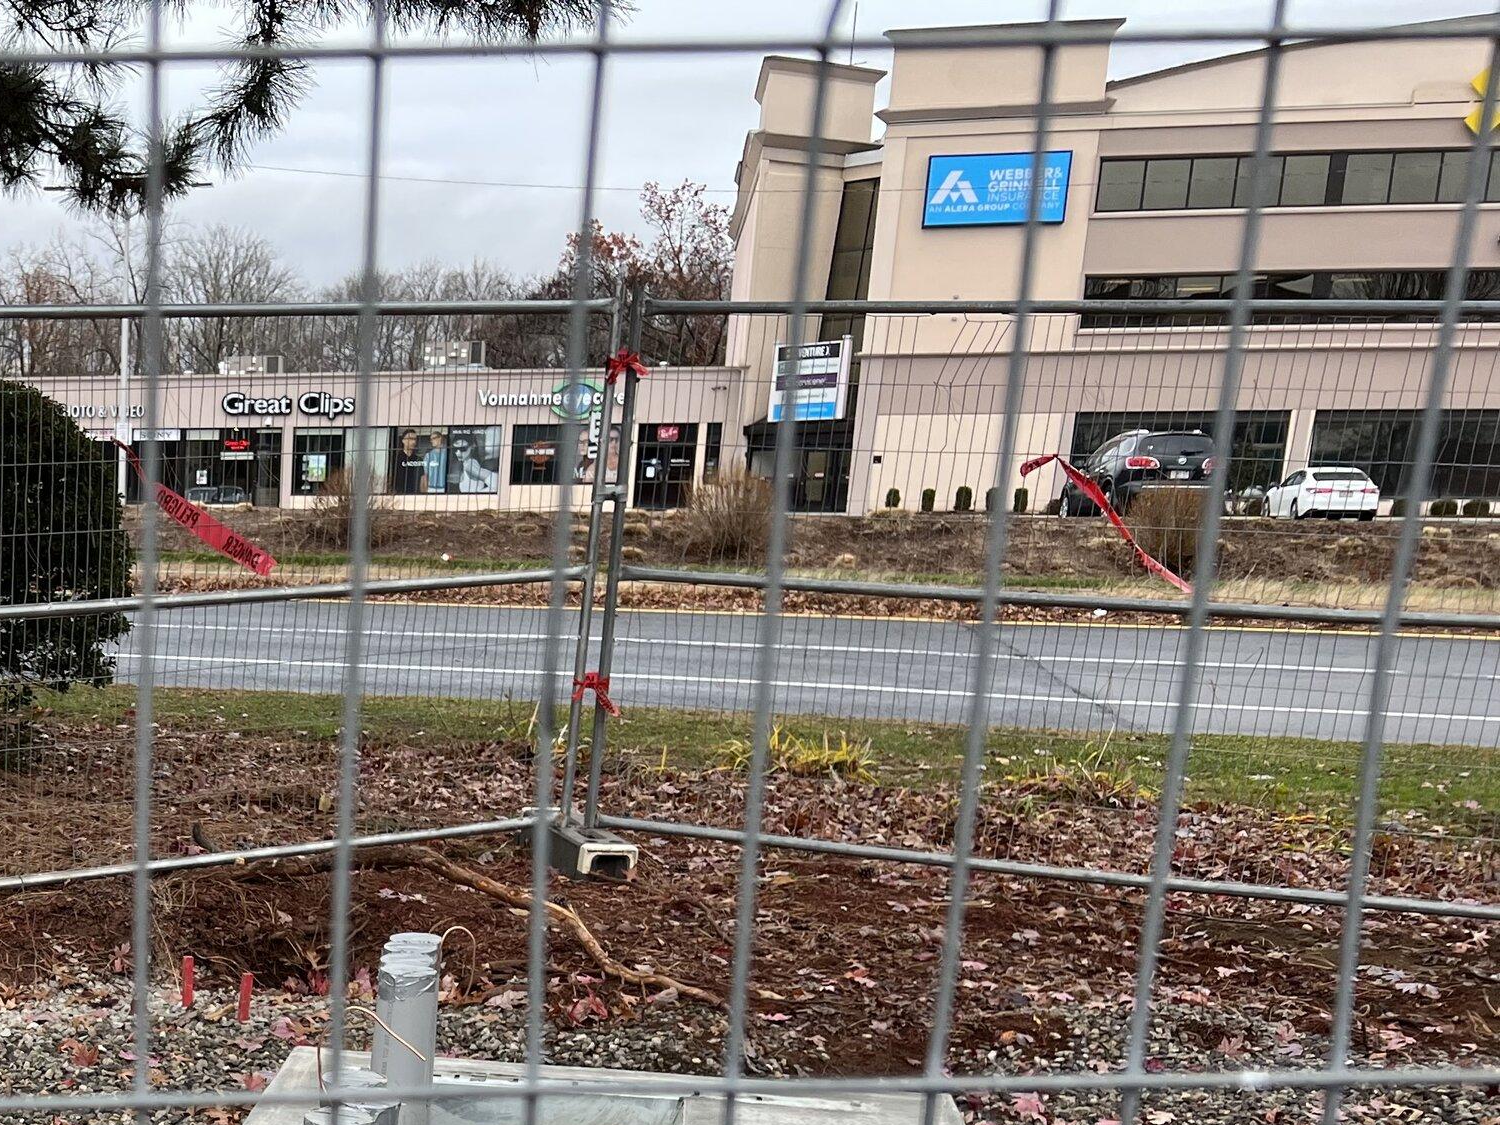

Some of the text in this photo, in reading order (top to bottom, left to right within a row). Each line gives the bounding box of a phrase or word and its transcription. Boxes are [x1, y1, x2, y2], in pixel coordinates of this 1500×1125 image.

[988, 179, 1060, 192] GRINNLL
[987, 191, 1059, 202] INSURACE
[944, 203, 975, 213] ALERA
[977, 203, 1010, 212] GROUP
[1012, 201, 1060, 210] COANY
[98, 405, 107, 418] &
[222, 392, 355, 420] Great Clips
[140, 430, 173, 440] SNY
